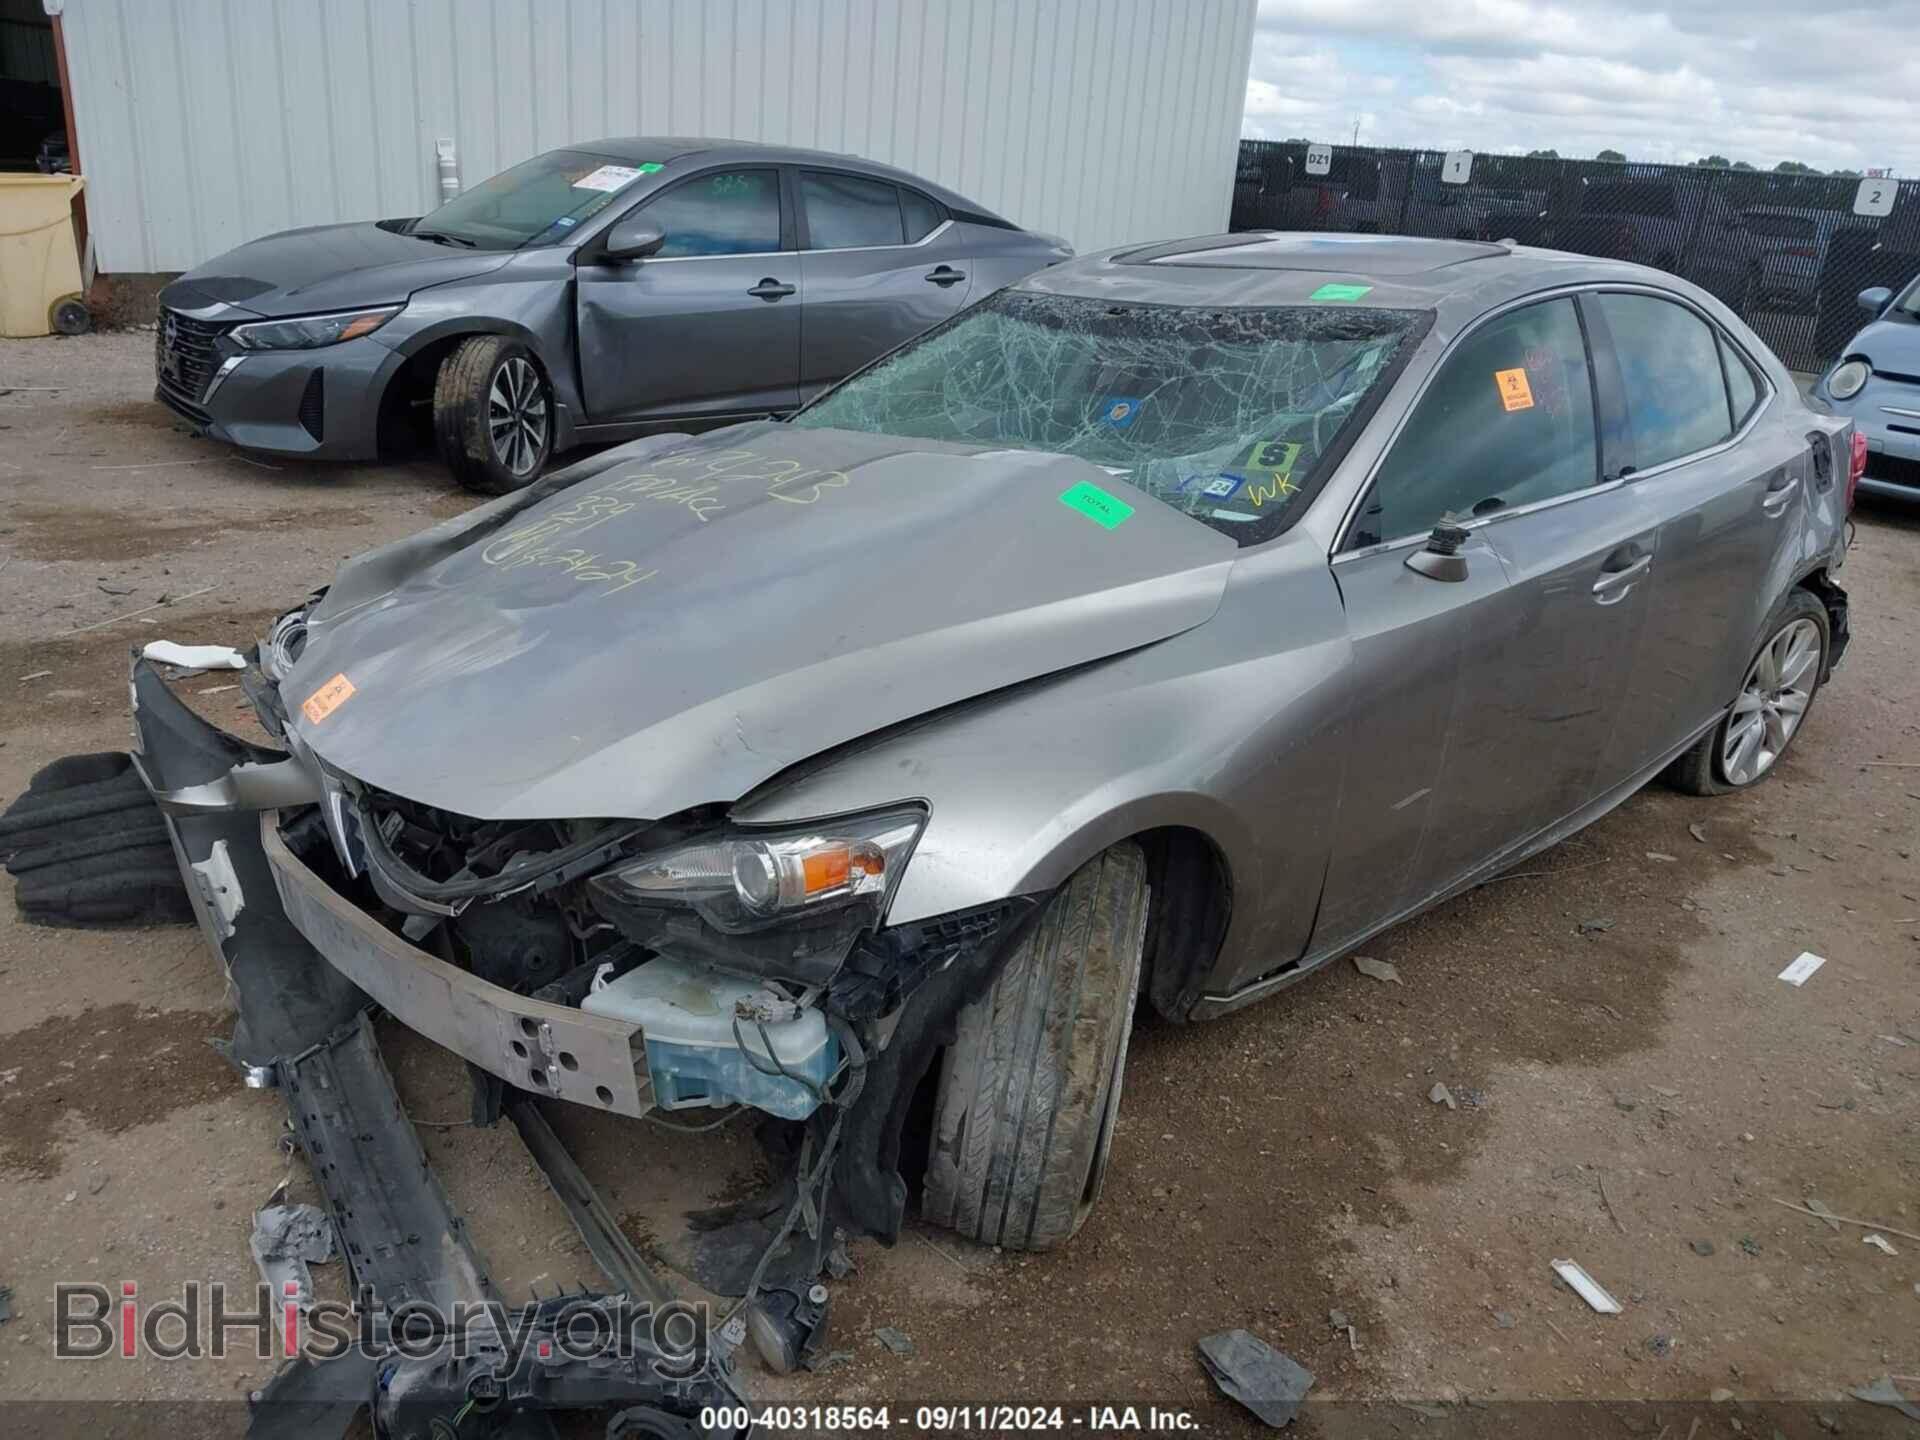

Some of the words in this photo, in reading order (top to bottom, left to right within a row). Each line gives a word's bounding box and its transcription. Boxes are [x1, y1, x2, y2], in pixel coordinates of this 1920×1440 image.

[1308, 154, 1329, 165] DZ1
[1454, 162, 1461, 173] 1
[1869, 190, 1882, 204] 2
[1258, 443, 1290, 466] S
